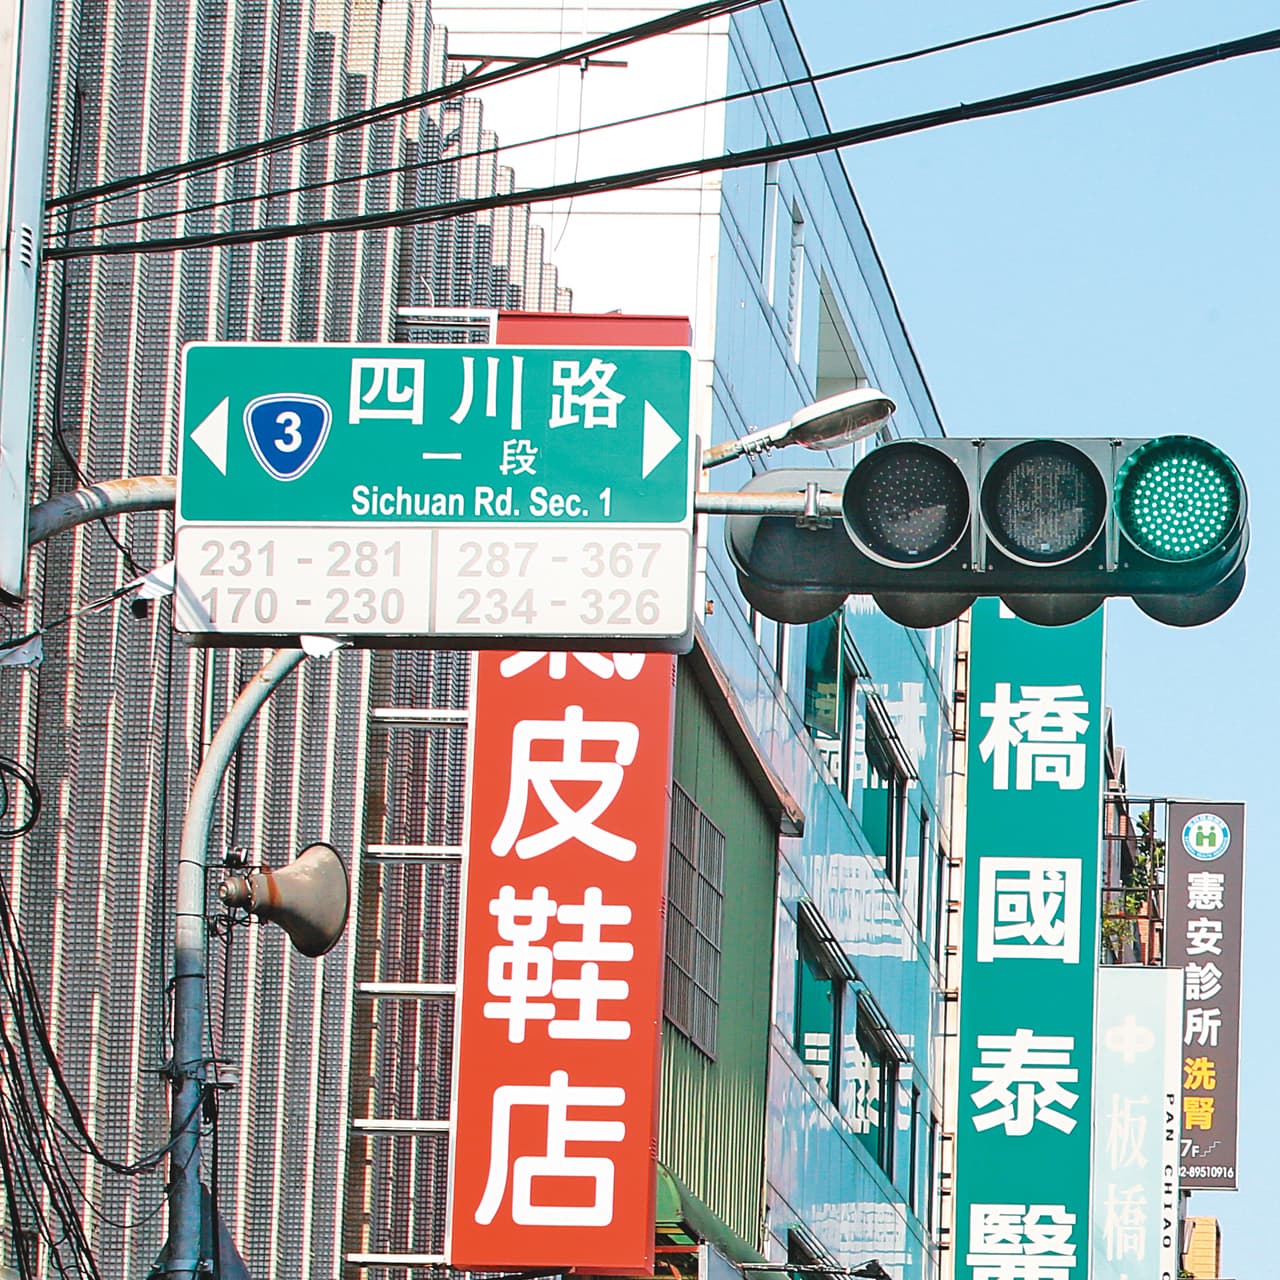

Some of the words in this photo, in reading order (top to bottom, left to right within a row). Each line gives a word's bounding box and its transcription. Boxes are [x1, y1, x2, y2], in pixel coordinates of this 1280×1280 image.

[347, 356, 627, 430] 四川路
[274, 411, 302, 453] 3
[422, 437, 539, 476] 一段
[351, 486, 468, 517] Sichuan
[475, 486, 521, 517] Rd.
[530, 486, 590, 517] Sec.
[598, 487, 612, 516] 1
[200, 539, 277, 577] 231
[326, 539, 402, 577] 281
[458, 539, 536, 577] 287
[581, 539, 661, 577] 367
[203, 586, 275, 625] 170
[324, 586, 405, 625] 230
[456, 587, 537, 625] 234
[579, 587, 660, 625] 326
[474, 652, 646, 1227] 皮鞋店
[1183, 1057, 1216, 1131] 洗腎
[1165, 1094, 1175, 1142] PAN
[1161, 1164, 1174, 1249] CHIAO
